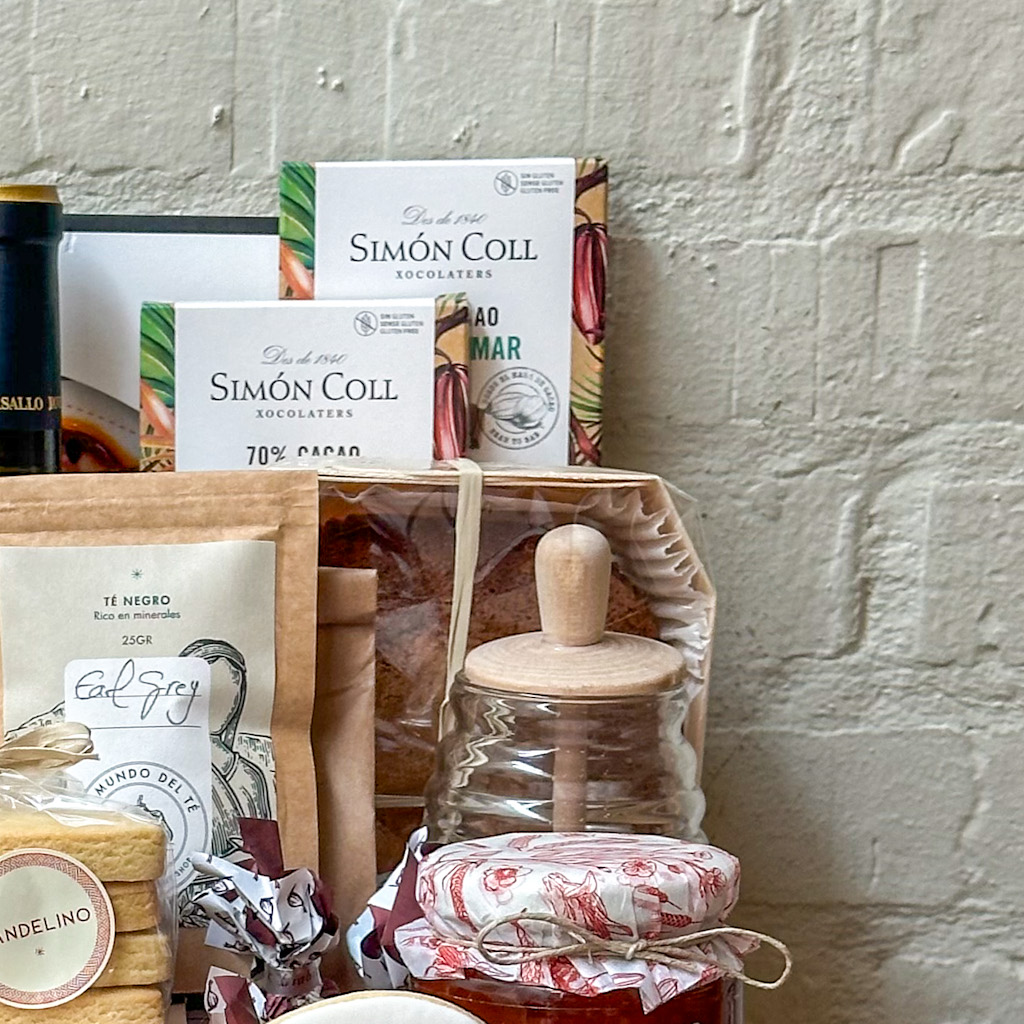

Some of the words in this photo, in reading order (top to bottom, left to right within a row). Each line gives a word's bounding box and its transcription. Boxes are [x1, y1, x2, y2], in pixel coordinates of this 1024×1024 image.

[453, 212, 489, 226] 1840
[395, 269, 493, 279] XOCOLATERS
[314, 352, 349, 365] 1840
[255, 409, 354, 418] XOCOLATERS
[246, 445, 287, 465] 70%
[103, 594, 118, 606] TÉ
[123, 595, 171, 606] NEGRO
[94, 610, 115, 620] Rico
[118, 612, 130, 620] en
[133, 608, 181, 620] minerales
[122, 635, 153, 645] 25GR
[74, 658, 136, 708] Earl
[138, 670, 200, 725] Grey
[95, 768, 151, 796] MUNDO
[157, 772, 183, 795] DEL
[183, 795, 201, 813] TÉ
